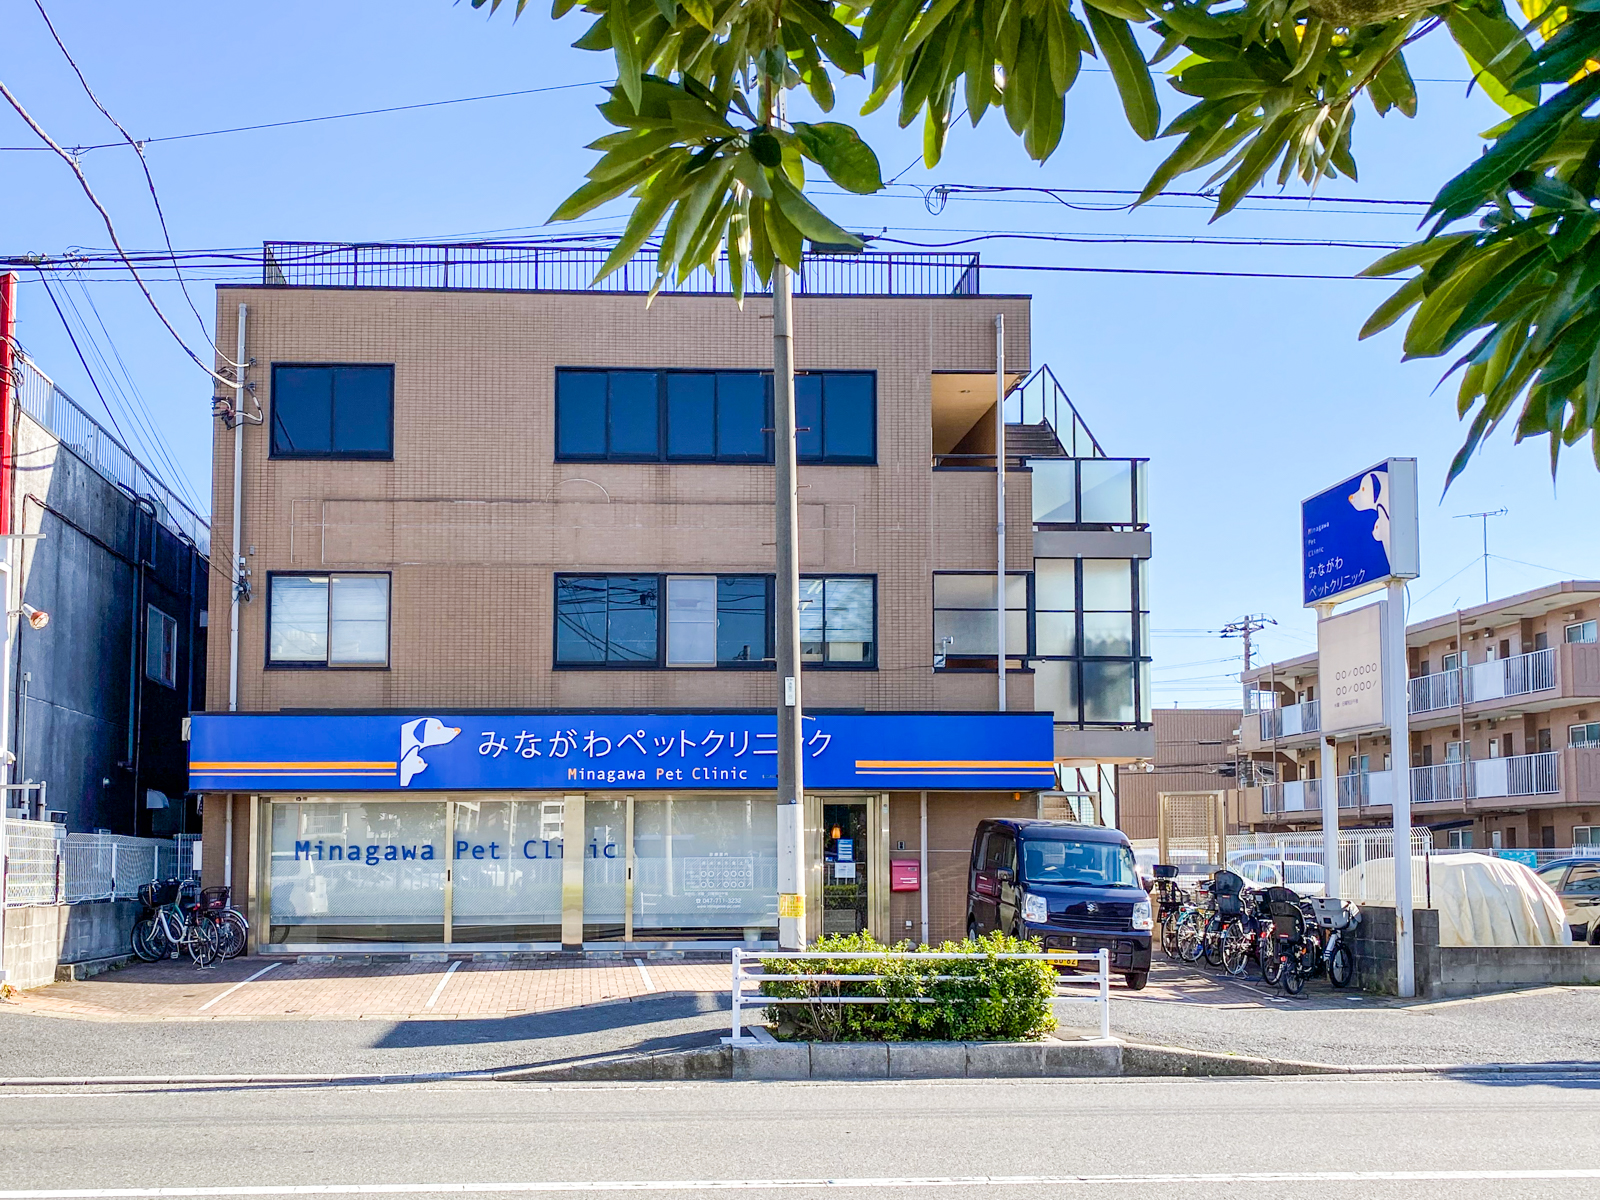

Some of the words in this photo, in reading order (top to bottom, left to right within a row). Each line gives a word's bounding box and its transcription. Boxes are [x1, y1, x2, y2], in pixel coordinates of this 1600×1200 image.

[1308, 556, 1344, 579] みながわ
[1308, 568, 1366, 597] ペットクリニック
[478, 728, 832, 759] みながわペットクリニク
[567, 767, 646, 783] Minagawa
[656, 767, 684, 780] Pet
[691, 766, 748, 780] Clinic
[294, 840, 435, 866] Minagawa
[455, 840, 501, 860] Pet
[523, 837, 616, 860] Cliic
